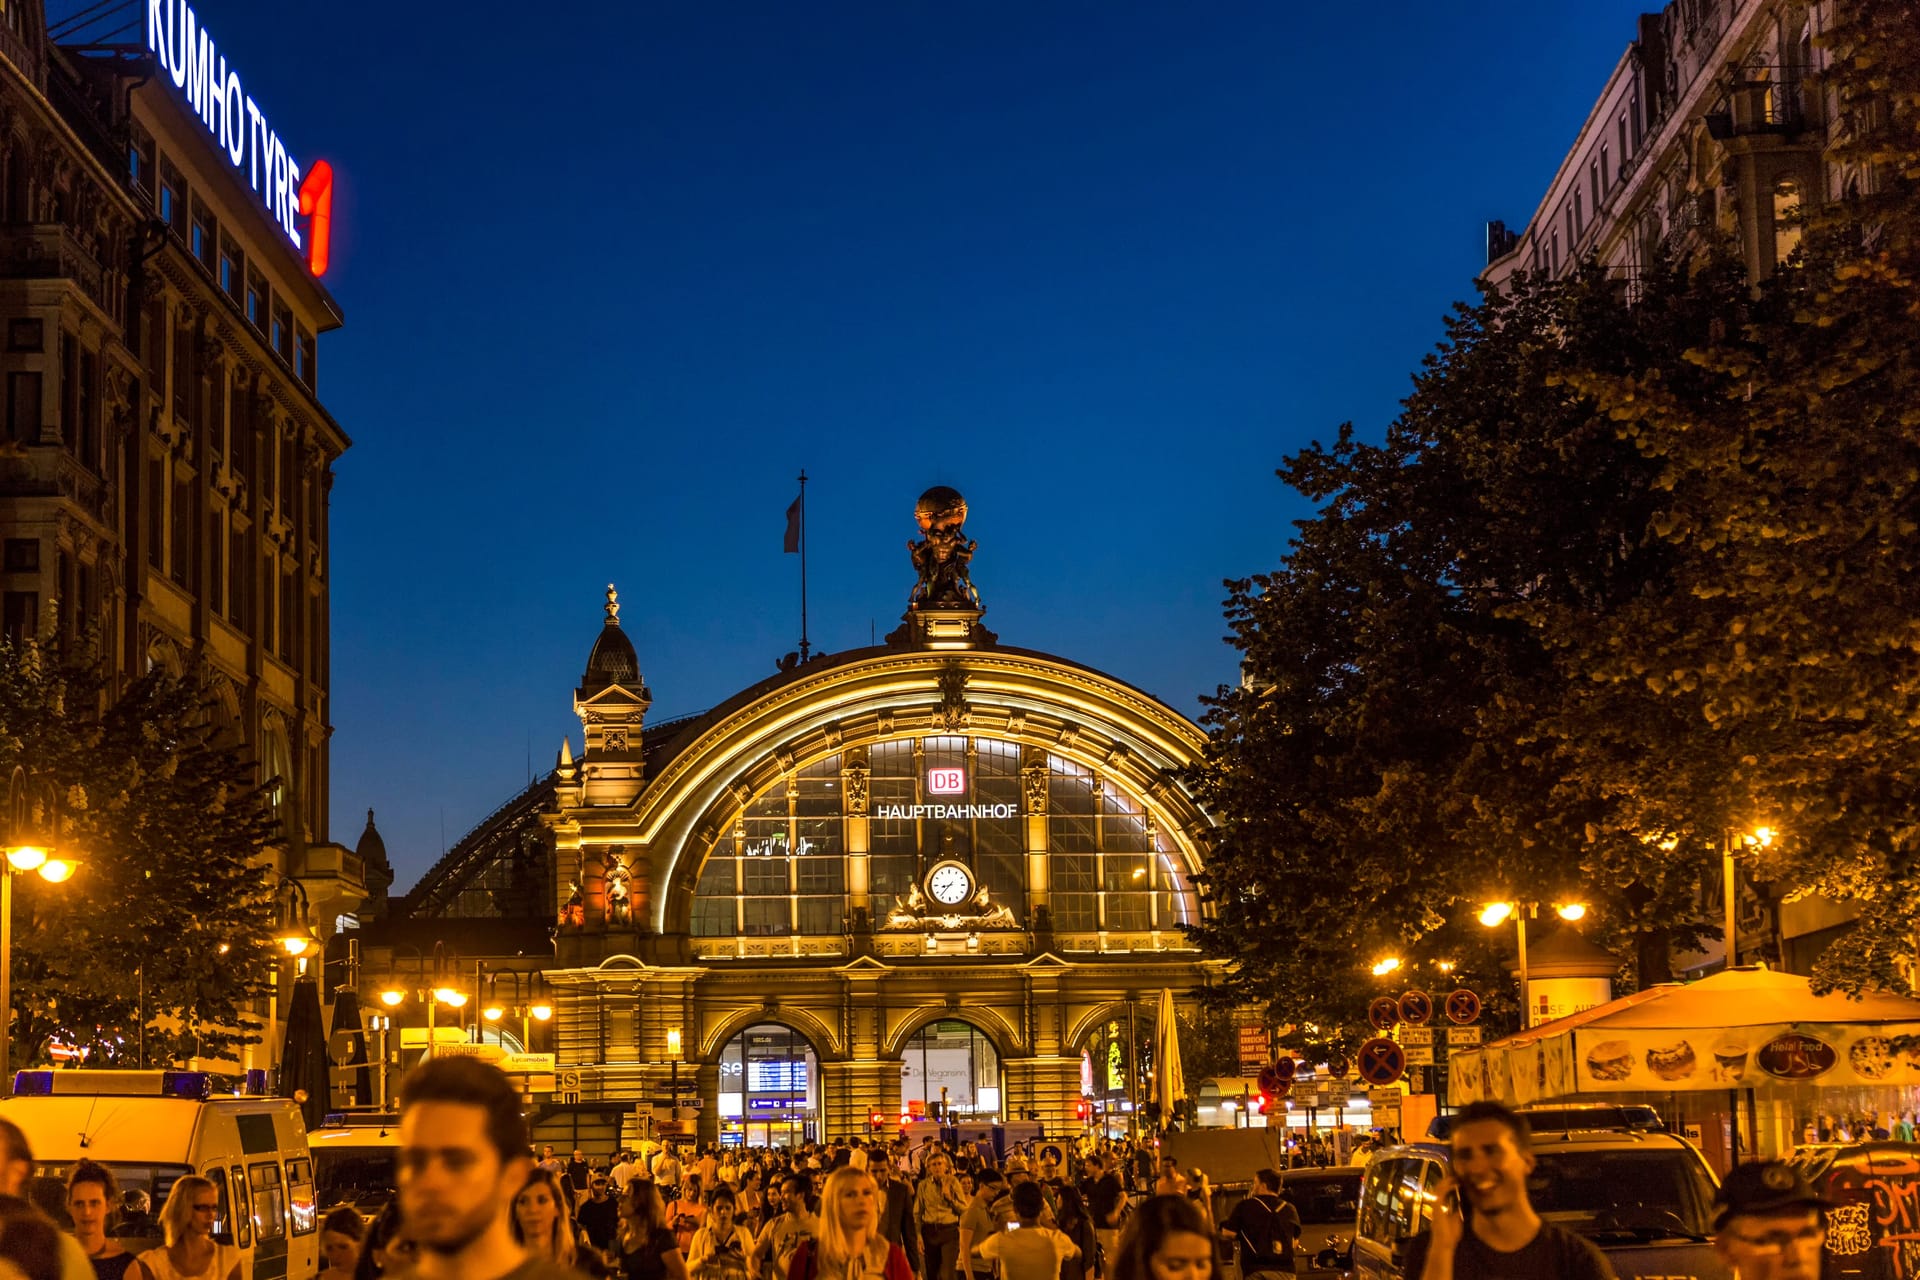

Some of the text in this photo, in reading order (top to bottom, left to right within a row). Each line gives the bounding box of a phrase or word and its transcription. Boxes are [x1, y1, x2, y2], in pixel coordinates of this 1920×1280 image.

[246, 95, 300, 250] TYRE
[299, 159, 334, 277] 1
[934, 773, 960, 789] DB
[878, 803, 1018, 820] HAUPTBAHNHOF
[1770, 1040, 1796, 1051] Halal
